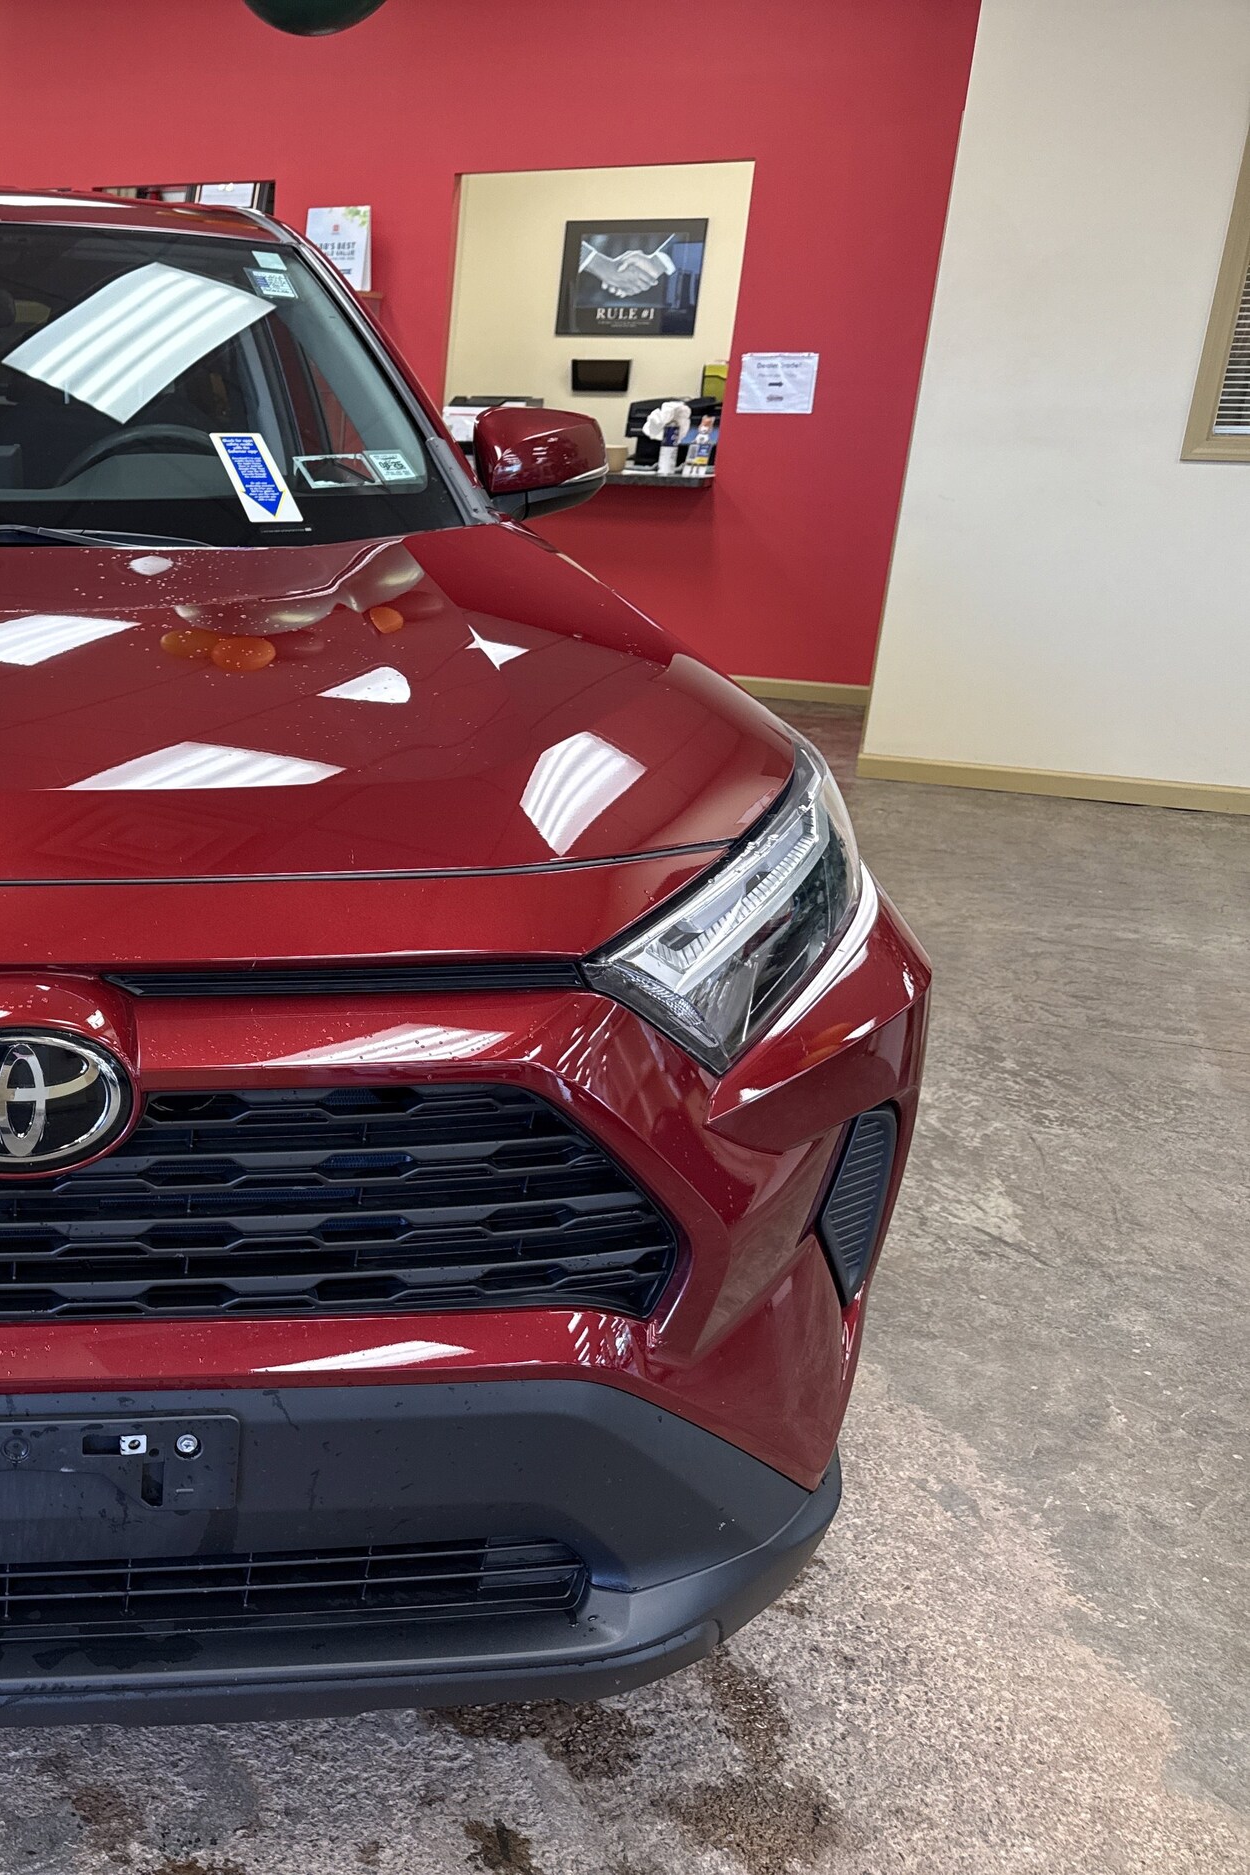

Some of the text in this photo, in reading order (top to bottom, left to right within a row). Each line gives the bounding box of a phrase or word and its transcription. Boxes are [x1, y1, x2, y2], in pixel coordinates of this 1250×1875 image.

[337, 242, 356, 250] BEST
[596, 307, 655, 320] RULE #1
